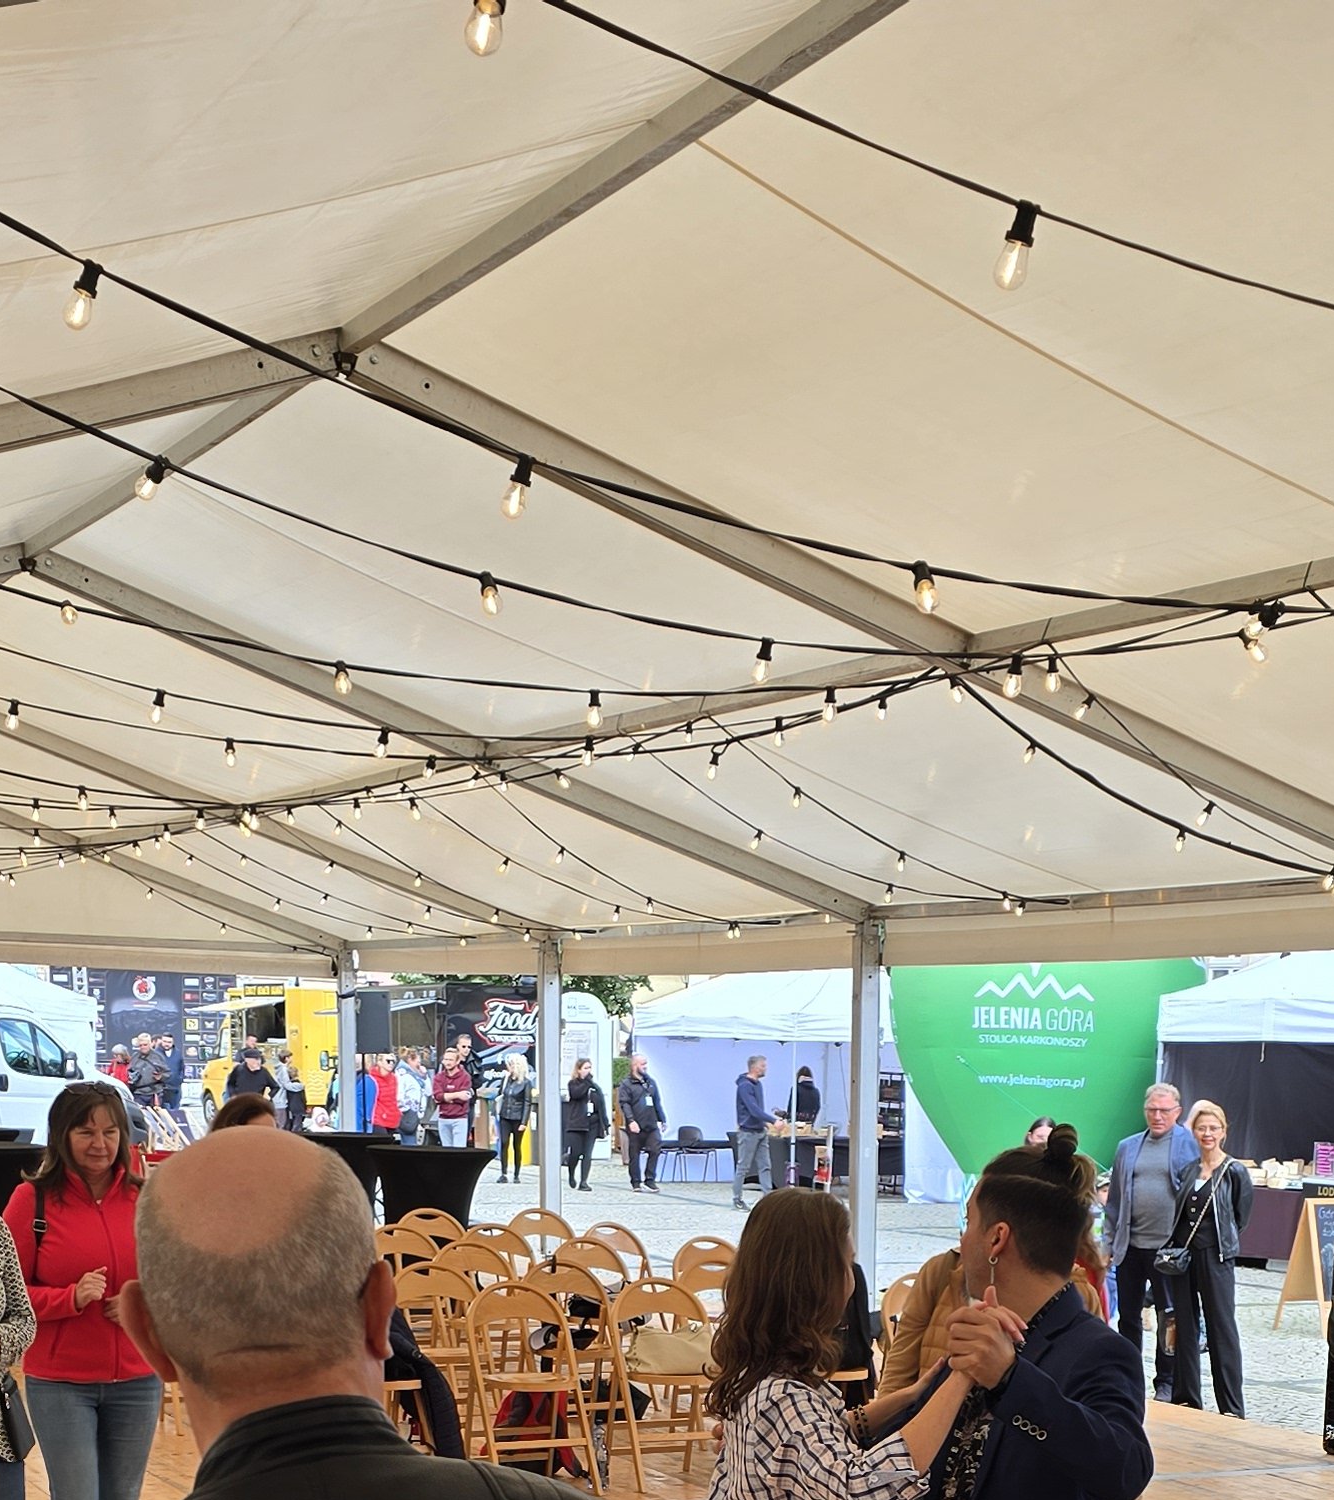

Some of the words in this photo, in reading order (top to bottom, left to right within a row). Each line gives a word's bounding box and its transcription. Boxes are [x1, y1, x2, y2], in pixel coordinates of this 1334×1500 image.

[972, 1006, 1042, 1030] JELENIA
[1046, 1006, 1095, 1033] GÓRA
[979, 1034, 1018, 1044] STOLICA
[1020, 1036, 1087, 1048] KARKONOSZY
[978, 1074, 1085, 1089] www.jeleniagora.pl
